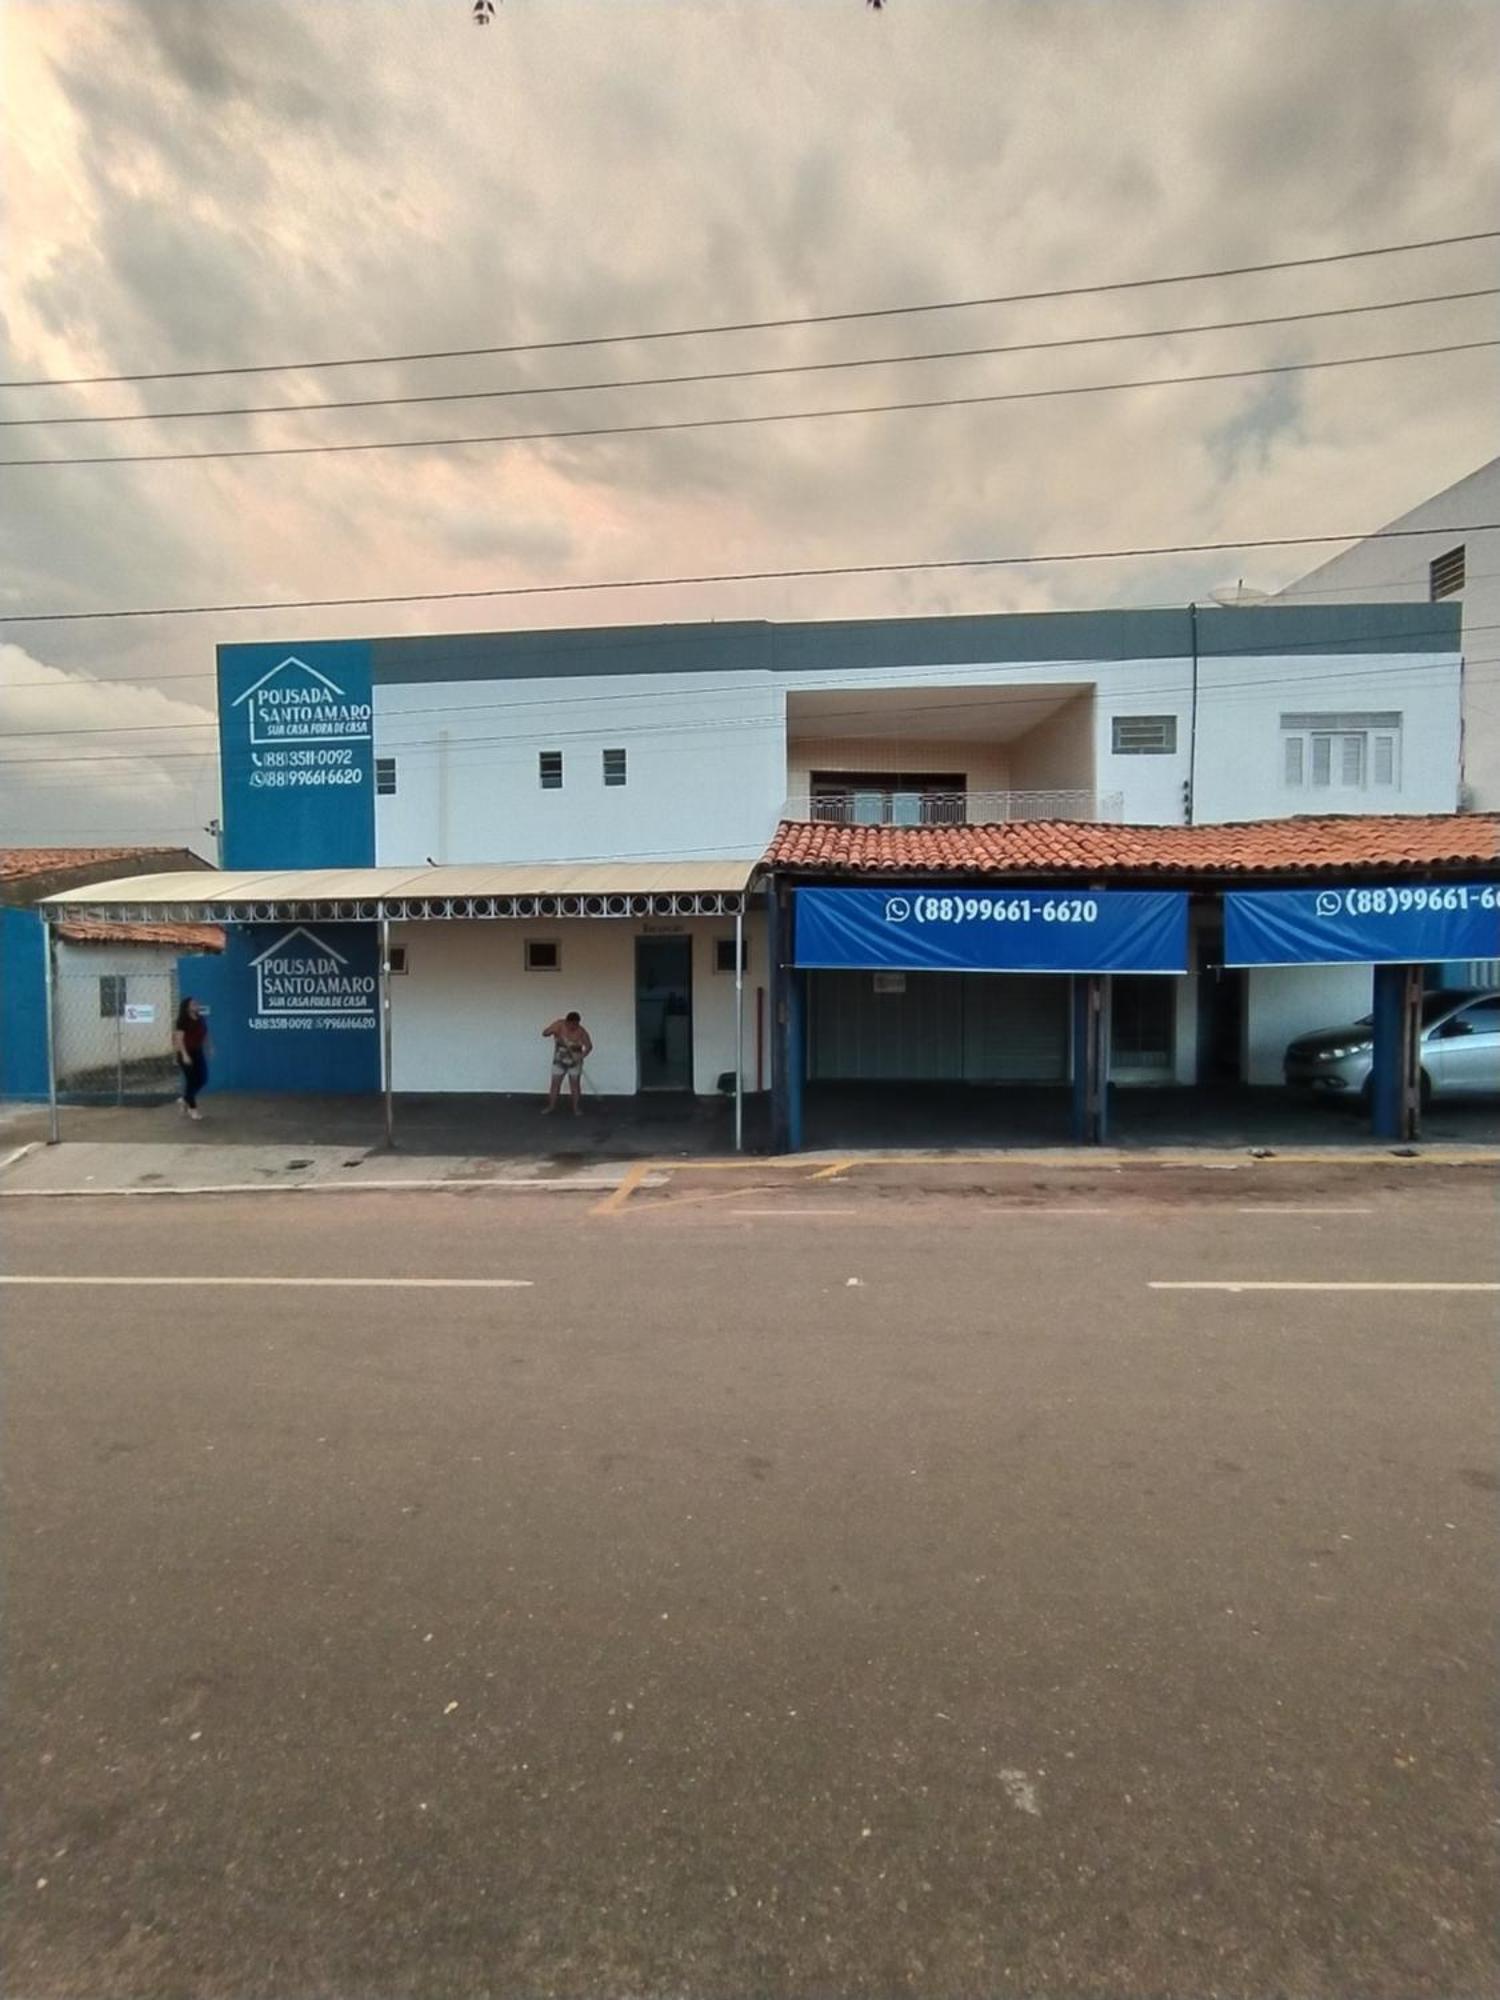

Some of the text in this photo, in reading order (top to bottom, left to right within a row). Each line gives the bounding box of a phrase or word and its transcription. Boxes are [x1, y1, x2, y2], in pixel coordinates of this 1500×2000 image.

[258, 687, 334, 705] POUSADA
[267, 724, 285, 736] SUA
[286, 723, 309, 735] CASA
[345, 721, 368, 733] CASA
[914, 895, 1098, 924] (88)99661-6620
[263, 958, 340, 975] POUSADA
